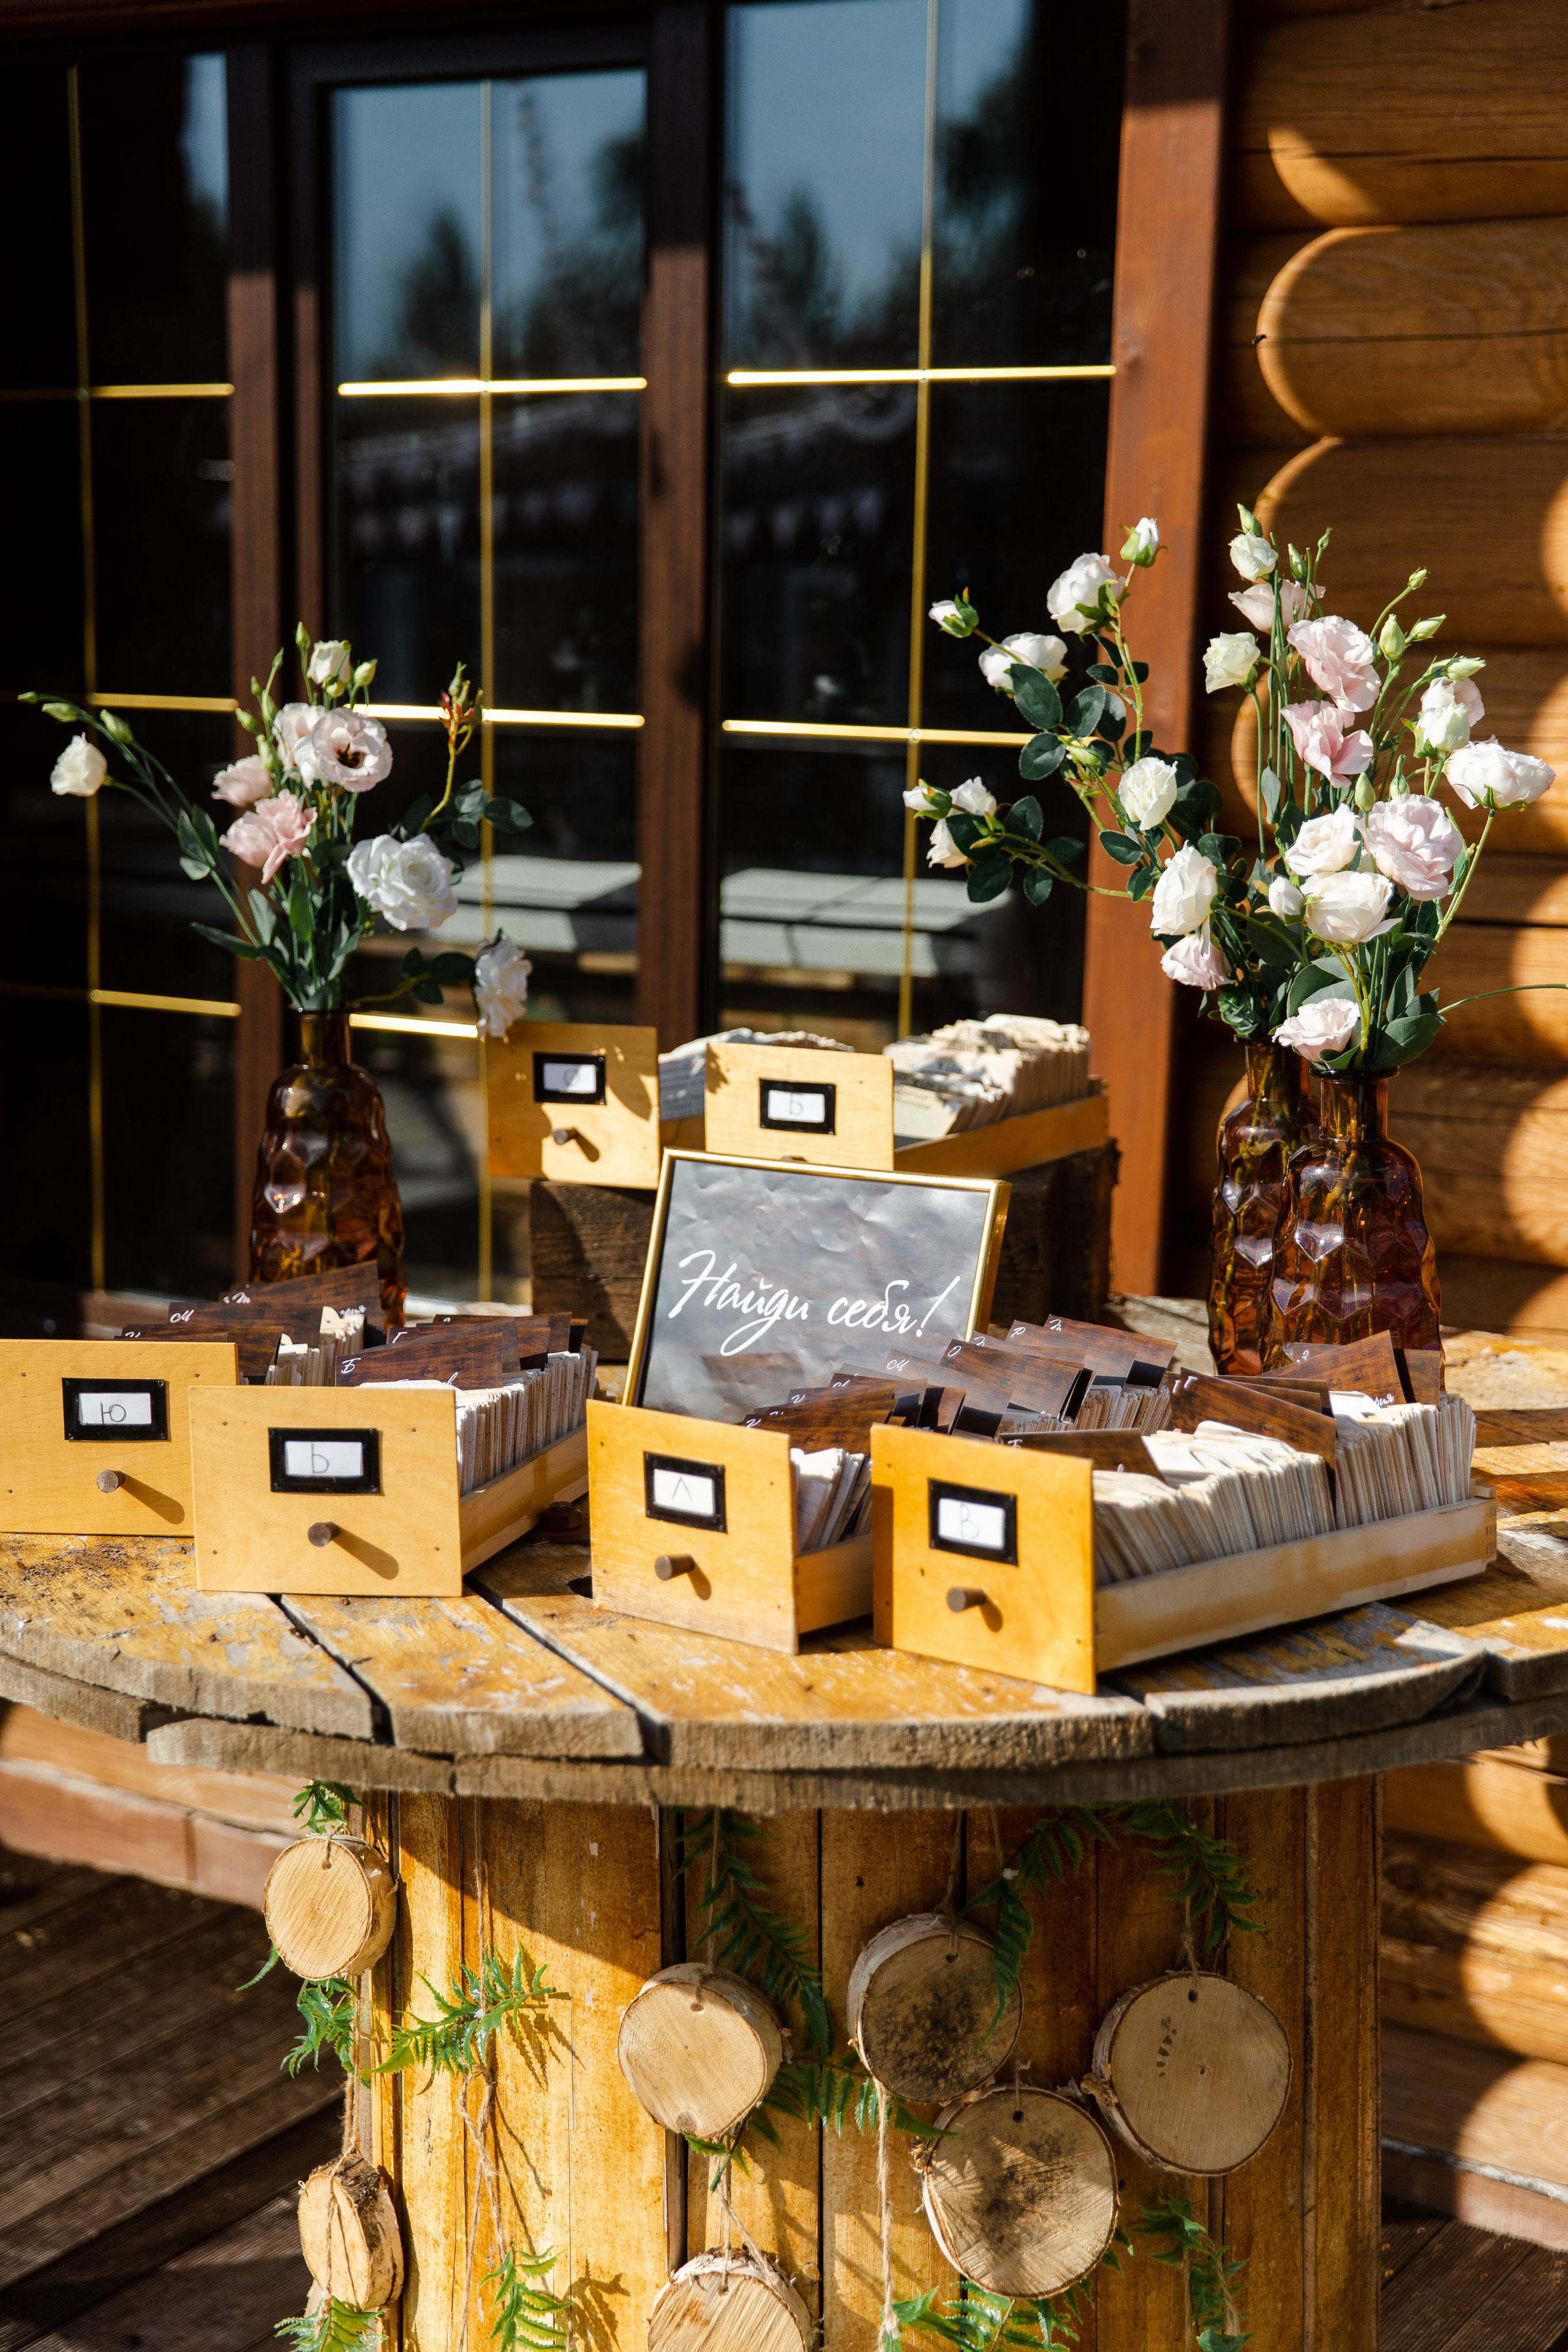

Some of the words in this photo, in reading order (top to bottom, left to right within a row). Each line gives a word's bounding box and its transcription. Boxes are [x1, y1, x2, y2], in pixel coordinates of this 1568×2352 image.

[668, 1249, 809, 1357] Найди
[827, 1275, 961, 1338] себя!
[947, 1346, 962, 1357] О
[341, 1357, 361, 1374] Б
[100, 1401, 127, 1424] Ю
